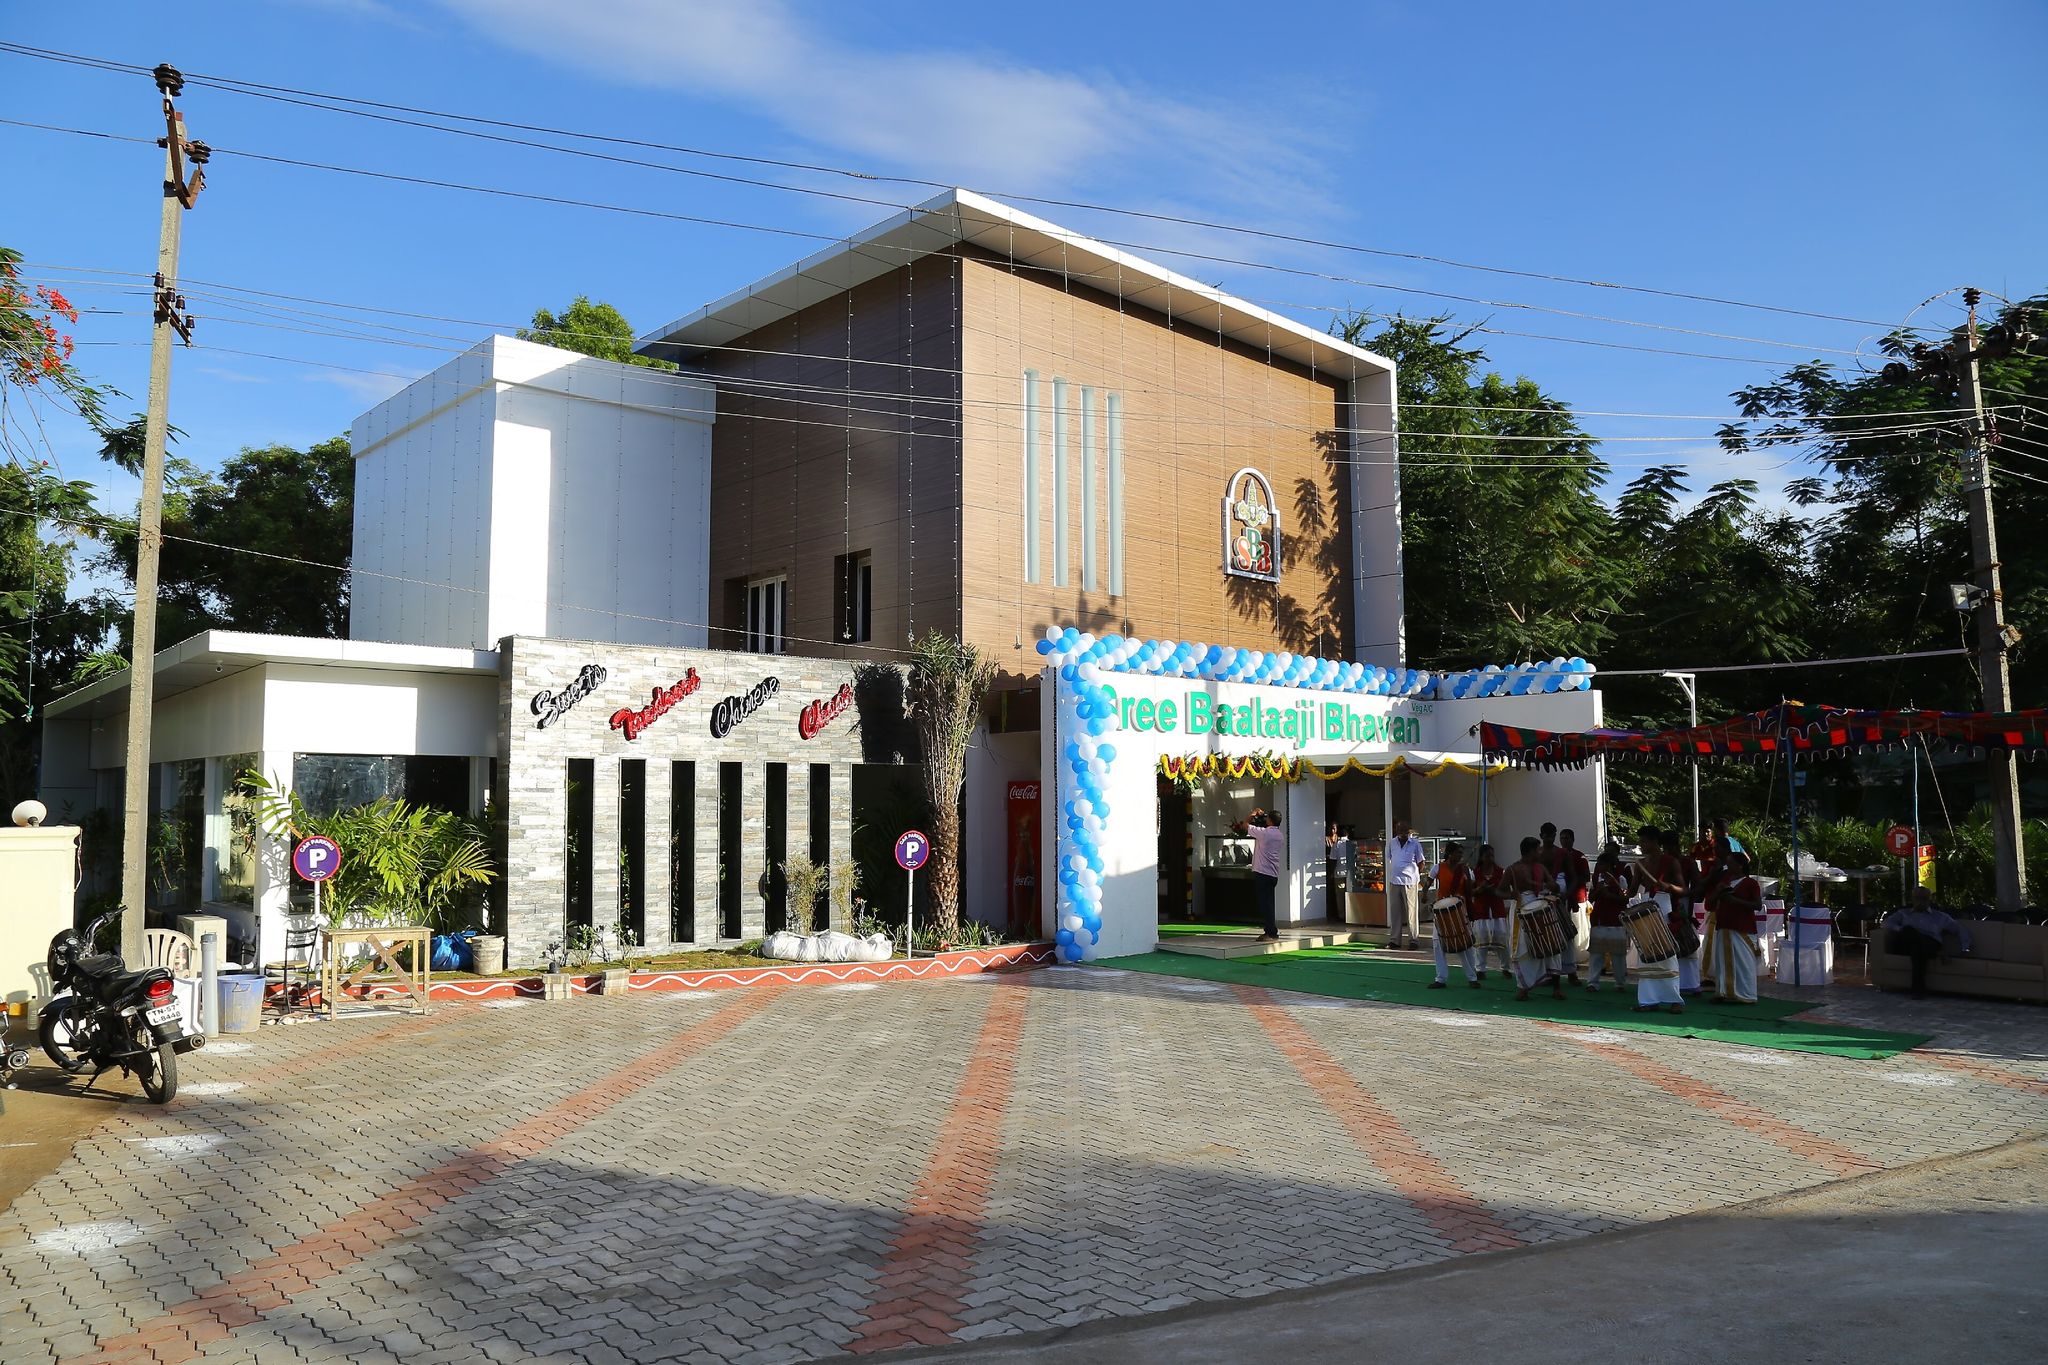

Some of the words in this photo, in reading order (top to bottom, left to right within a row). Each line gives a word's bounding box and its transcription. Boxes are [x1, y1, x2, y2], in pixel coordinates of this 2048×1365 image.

[530, 664, 607, 730] Sweets
[710, 676, 781, 739] Chinese
[1411, 702, 1423, 715] Veg
[1185, 691, 1315, 749] Baalaaji
[1321, 702, 1421, 744] Bhavan
[299, 841, 311, 853] CAR
[310, 838, 335, 851] PARKING
[906, 841, 920, 859] P
[1895, 833, 1909, 848] P
[309, 848, 327, 869] P
